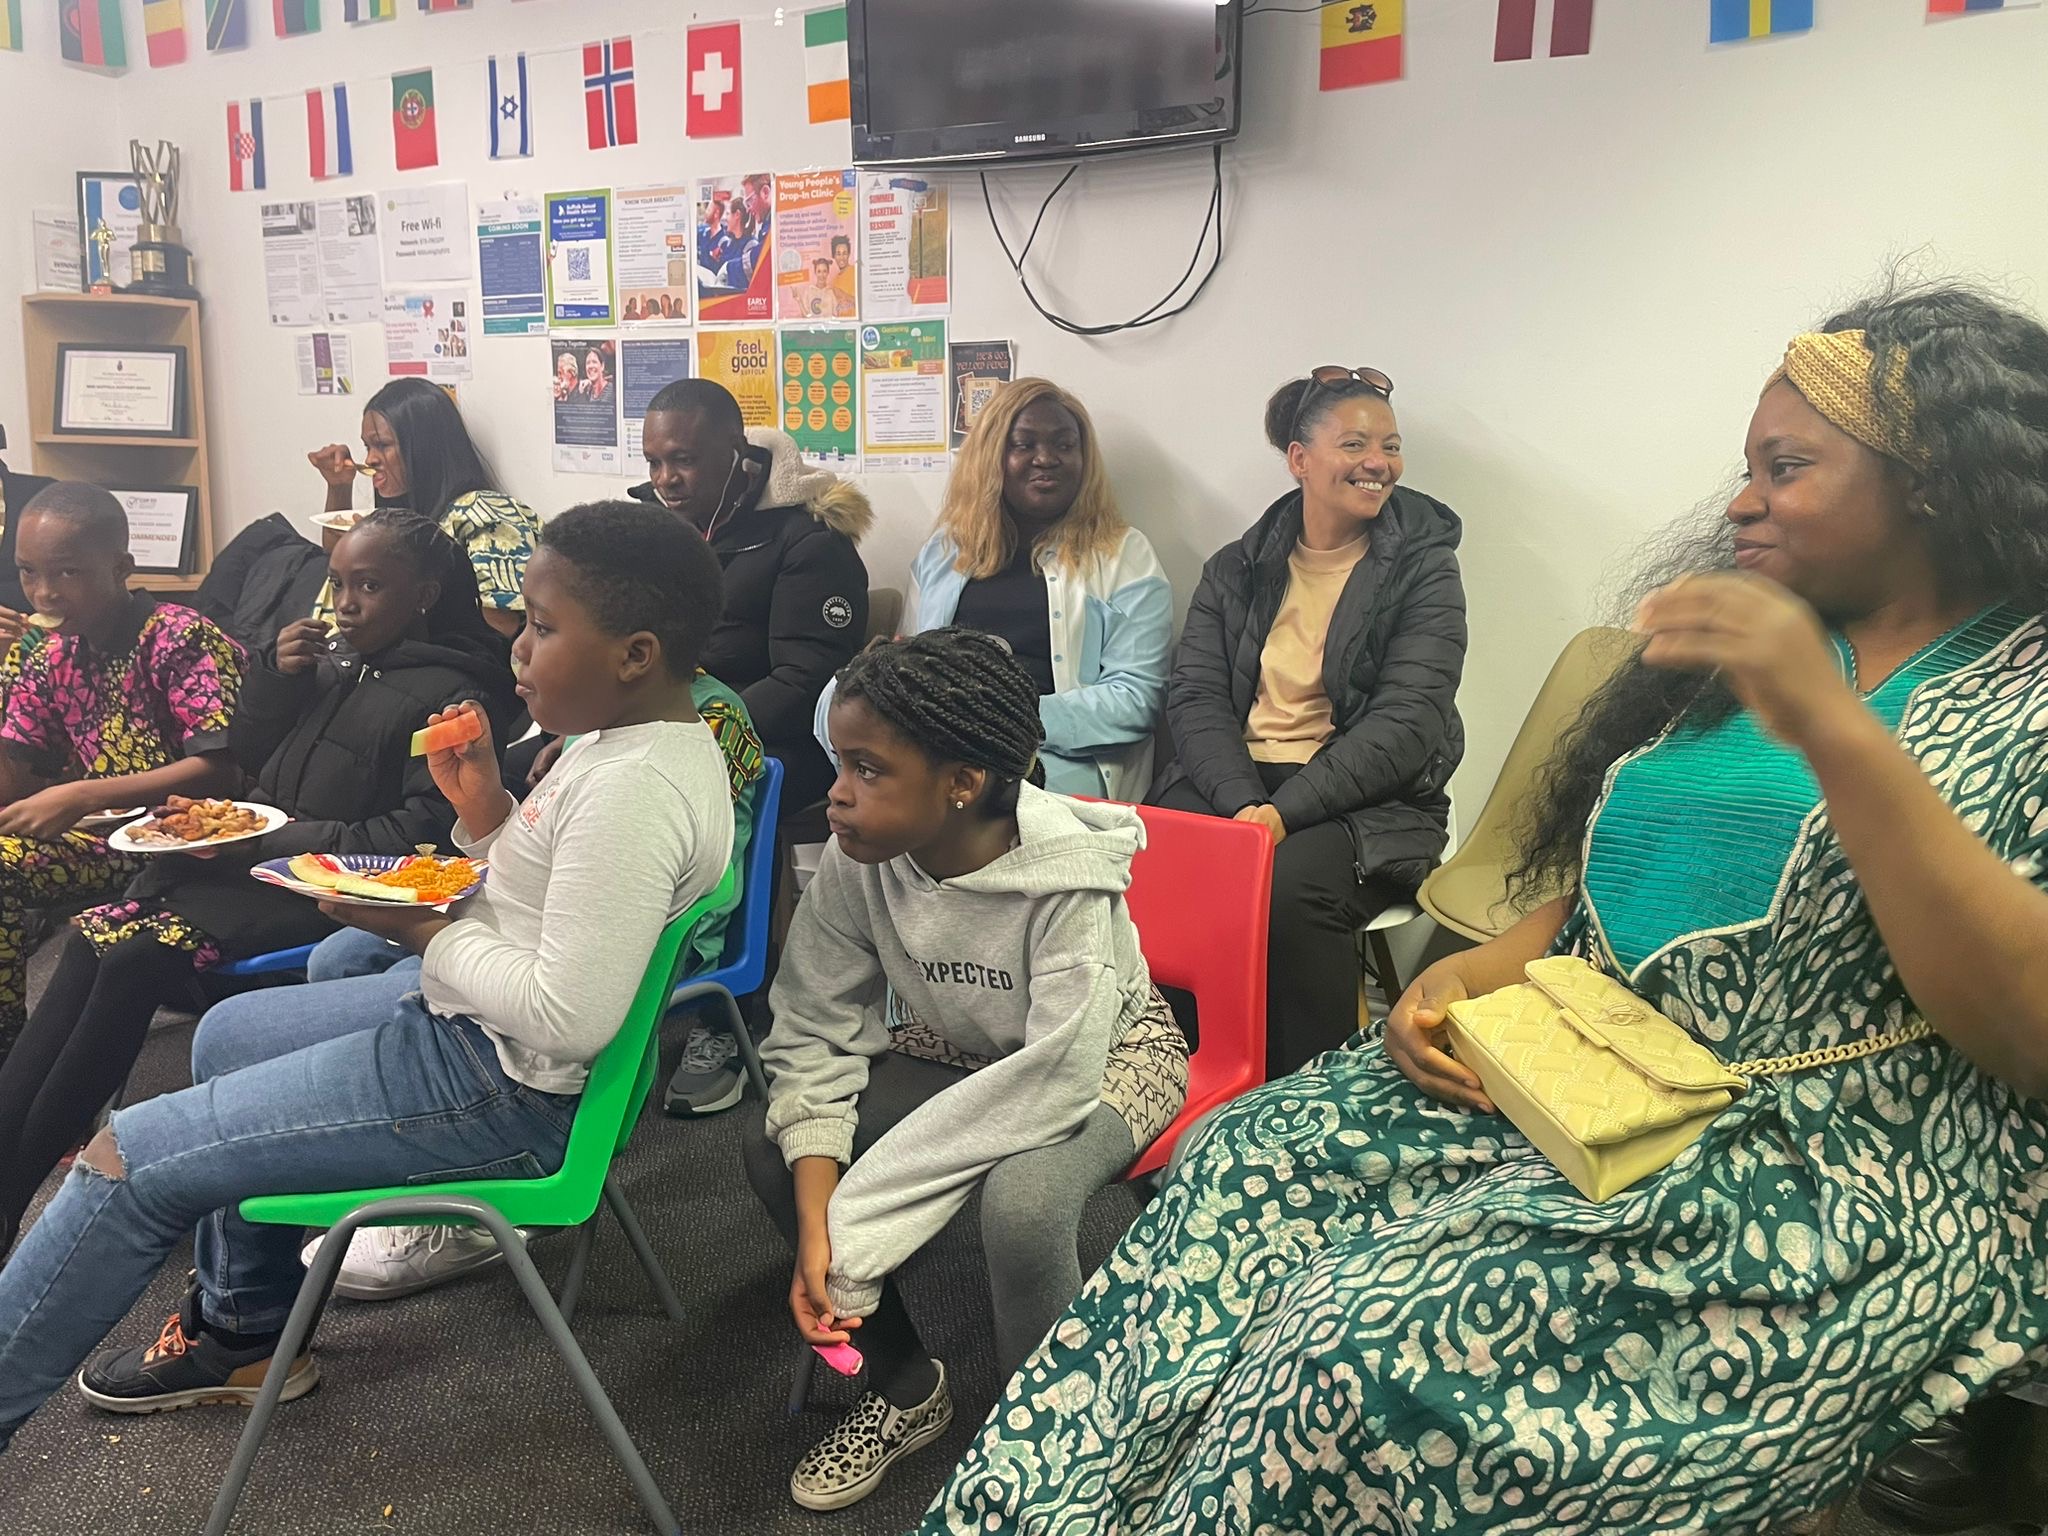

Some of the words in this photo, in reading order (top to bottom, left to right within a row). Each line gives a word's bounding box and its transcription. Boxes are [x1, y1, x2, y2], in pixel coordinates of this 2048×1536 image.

[1014, 134, 1046, 143] SAMSUNG
[780, 180, 804, 190] Young
[806, 176, 840, 188] People's
[780, 191, 810, 202] Drop-In
[810, 189, 834, 198] Clinic
[870, 206, 903, 217] BASKETBALL
[401, 220, 420, 232] Free
[421, 217, 441, 230] Wi-fi
[488, 224, 510, 232] COMING
[736, 339, 764, 354] feel
[732, 351, 768, 373] good
